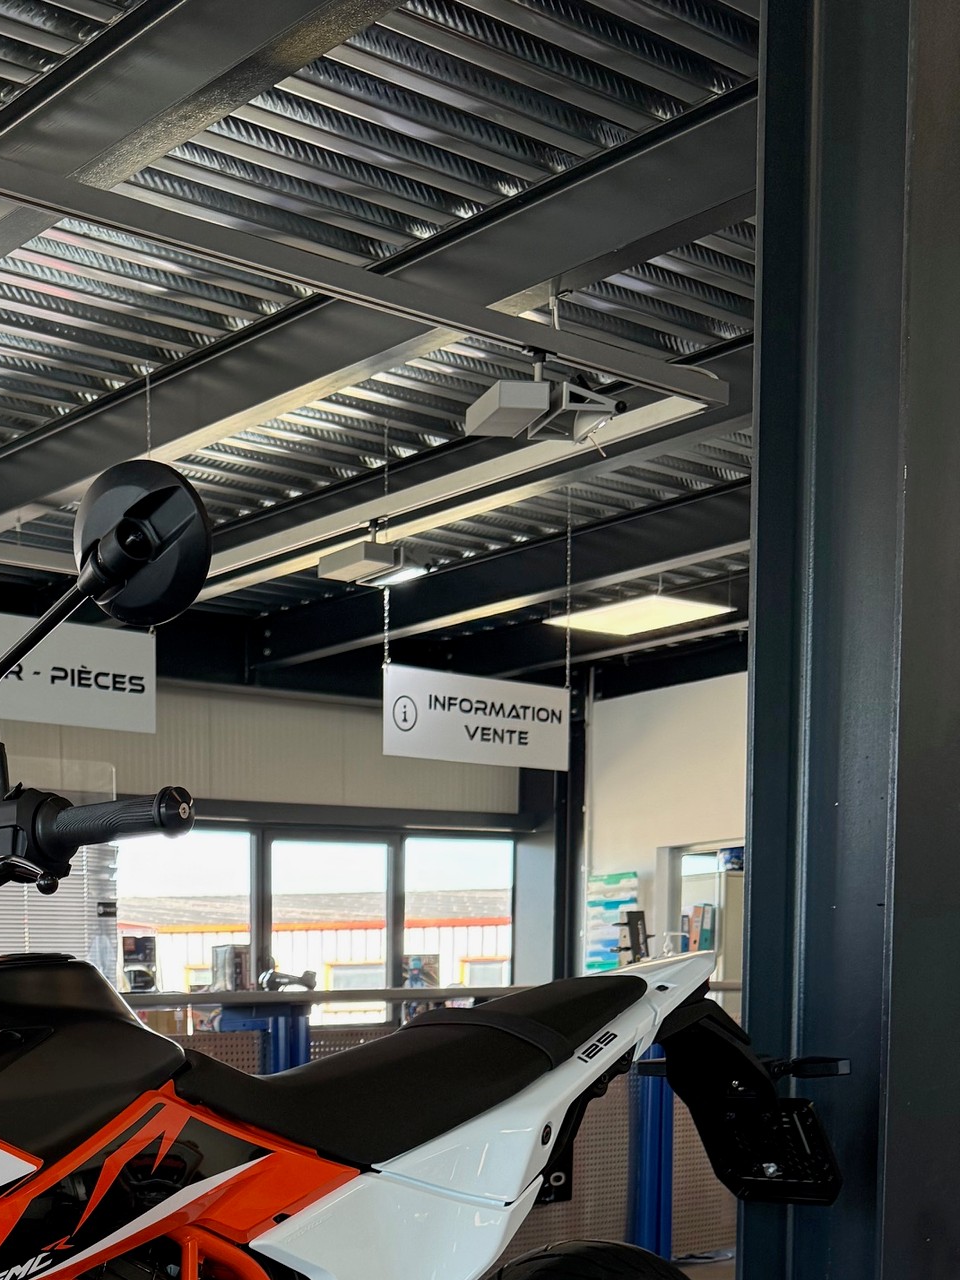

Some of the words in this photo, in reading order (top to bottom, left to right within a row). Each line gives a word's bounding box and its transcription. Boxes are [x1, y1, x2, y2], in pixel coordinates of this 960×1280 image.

[51, 664, 146, 694] PIÈCES
[428, 694, 563, 725] INFORMATION
[464, 724, 529, 746] VENTE
[577, 1030, 618, 1064] 125
